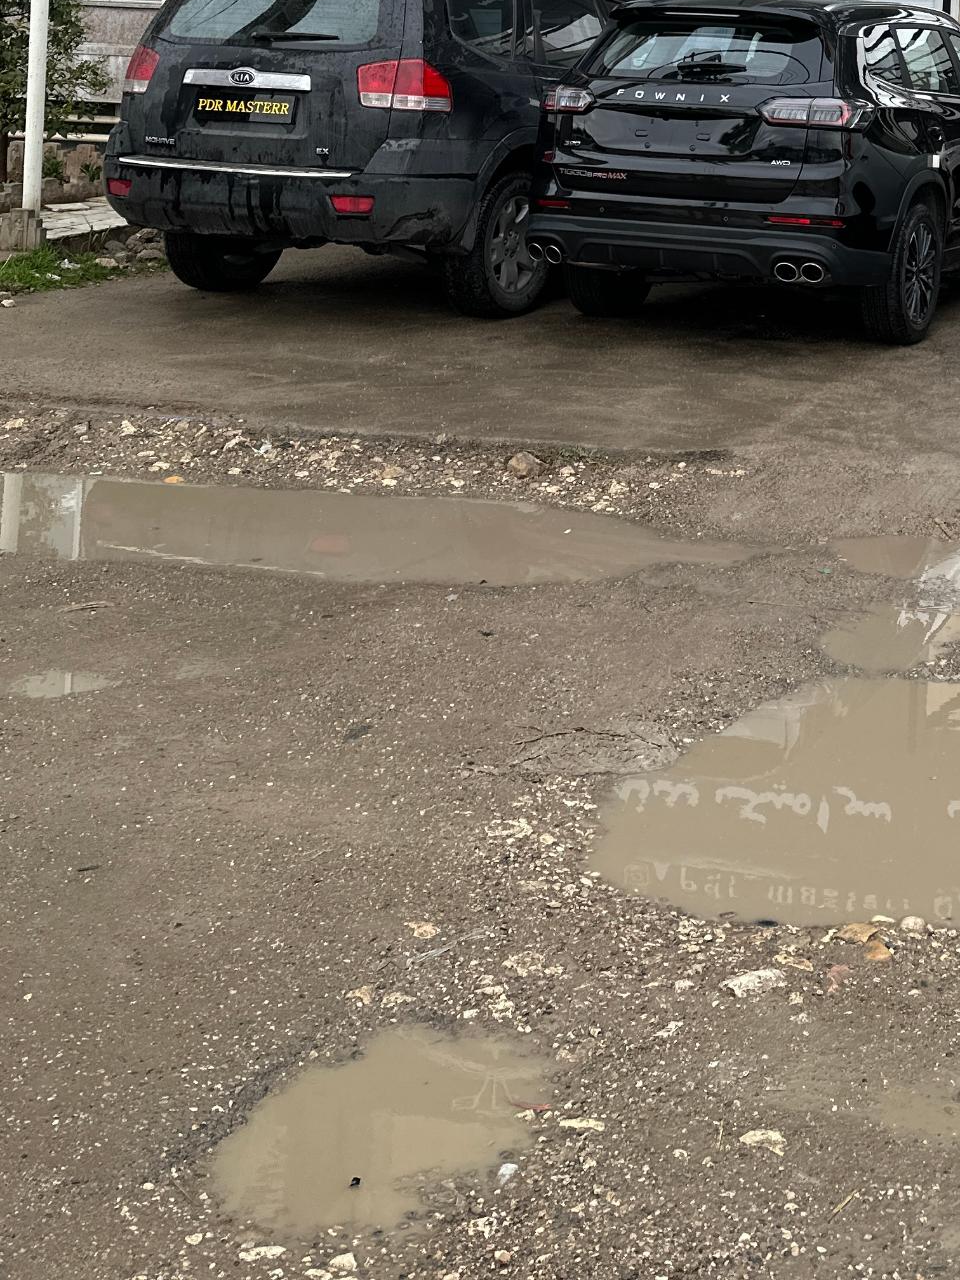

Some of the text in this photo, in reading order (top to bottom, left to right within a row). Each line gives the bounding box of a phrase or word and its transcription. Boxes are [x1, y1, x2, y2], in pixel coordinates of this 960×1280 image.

[615, 88, 731, 104] FOWNIX
[197, 98, 290, 116] PDR MASTERR
[316, 147, 330, 156] EX
